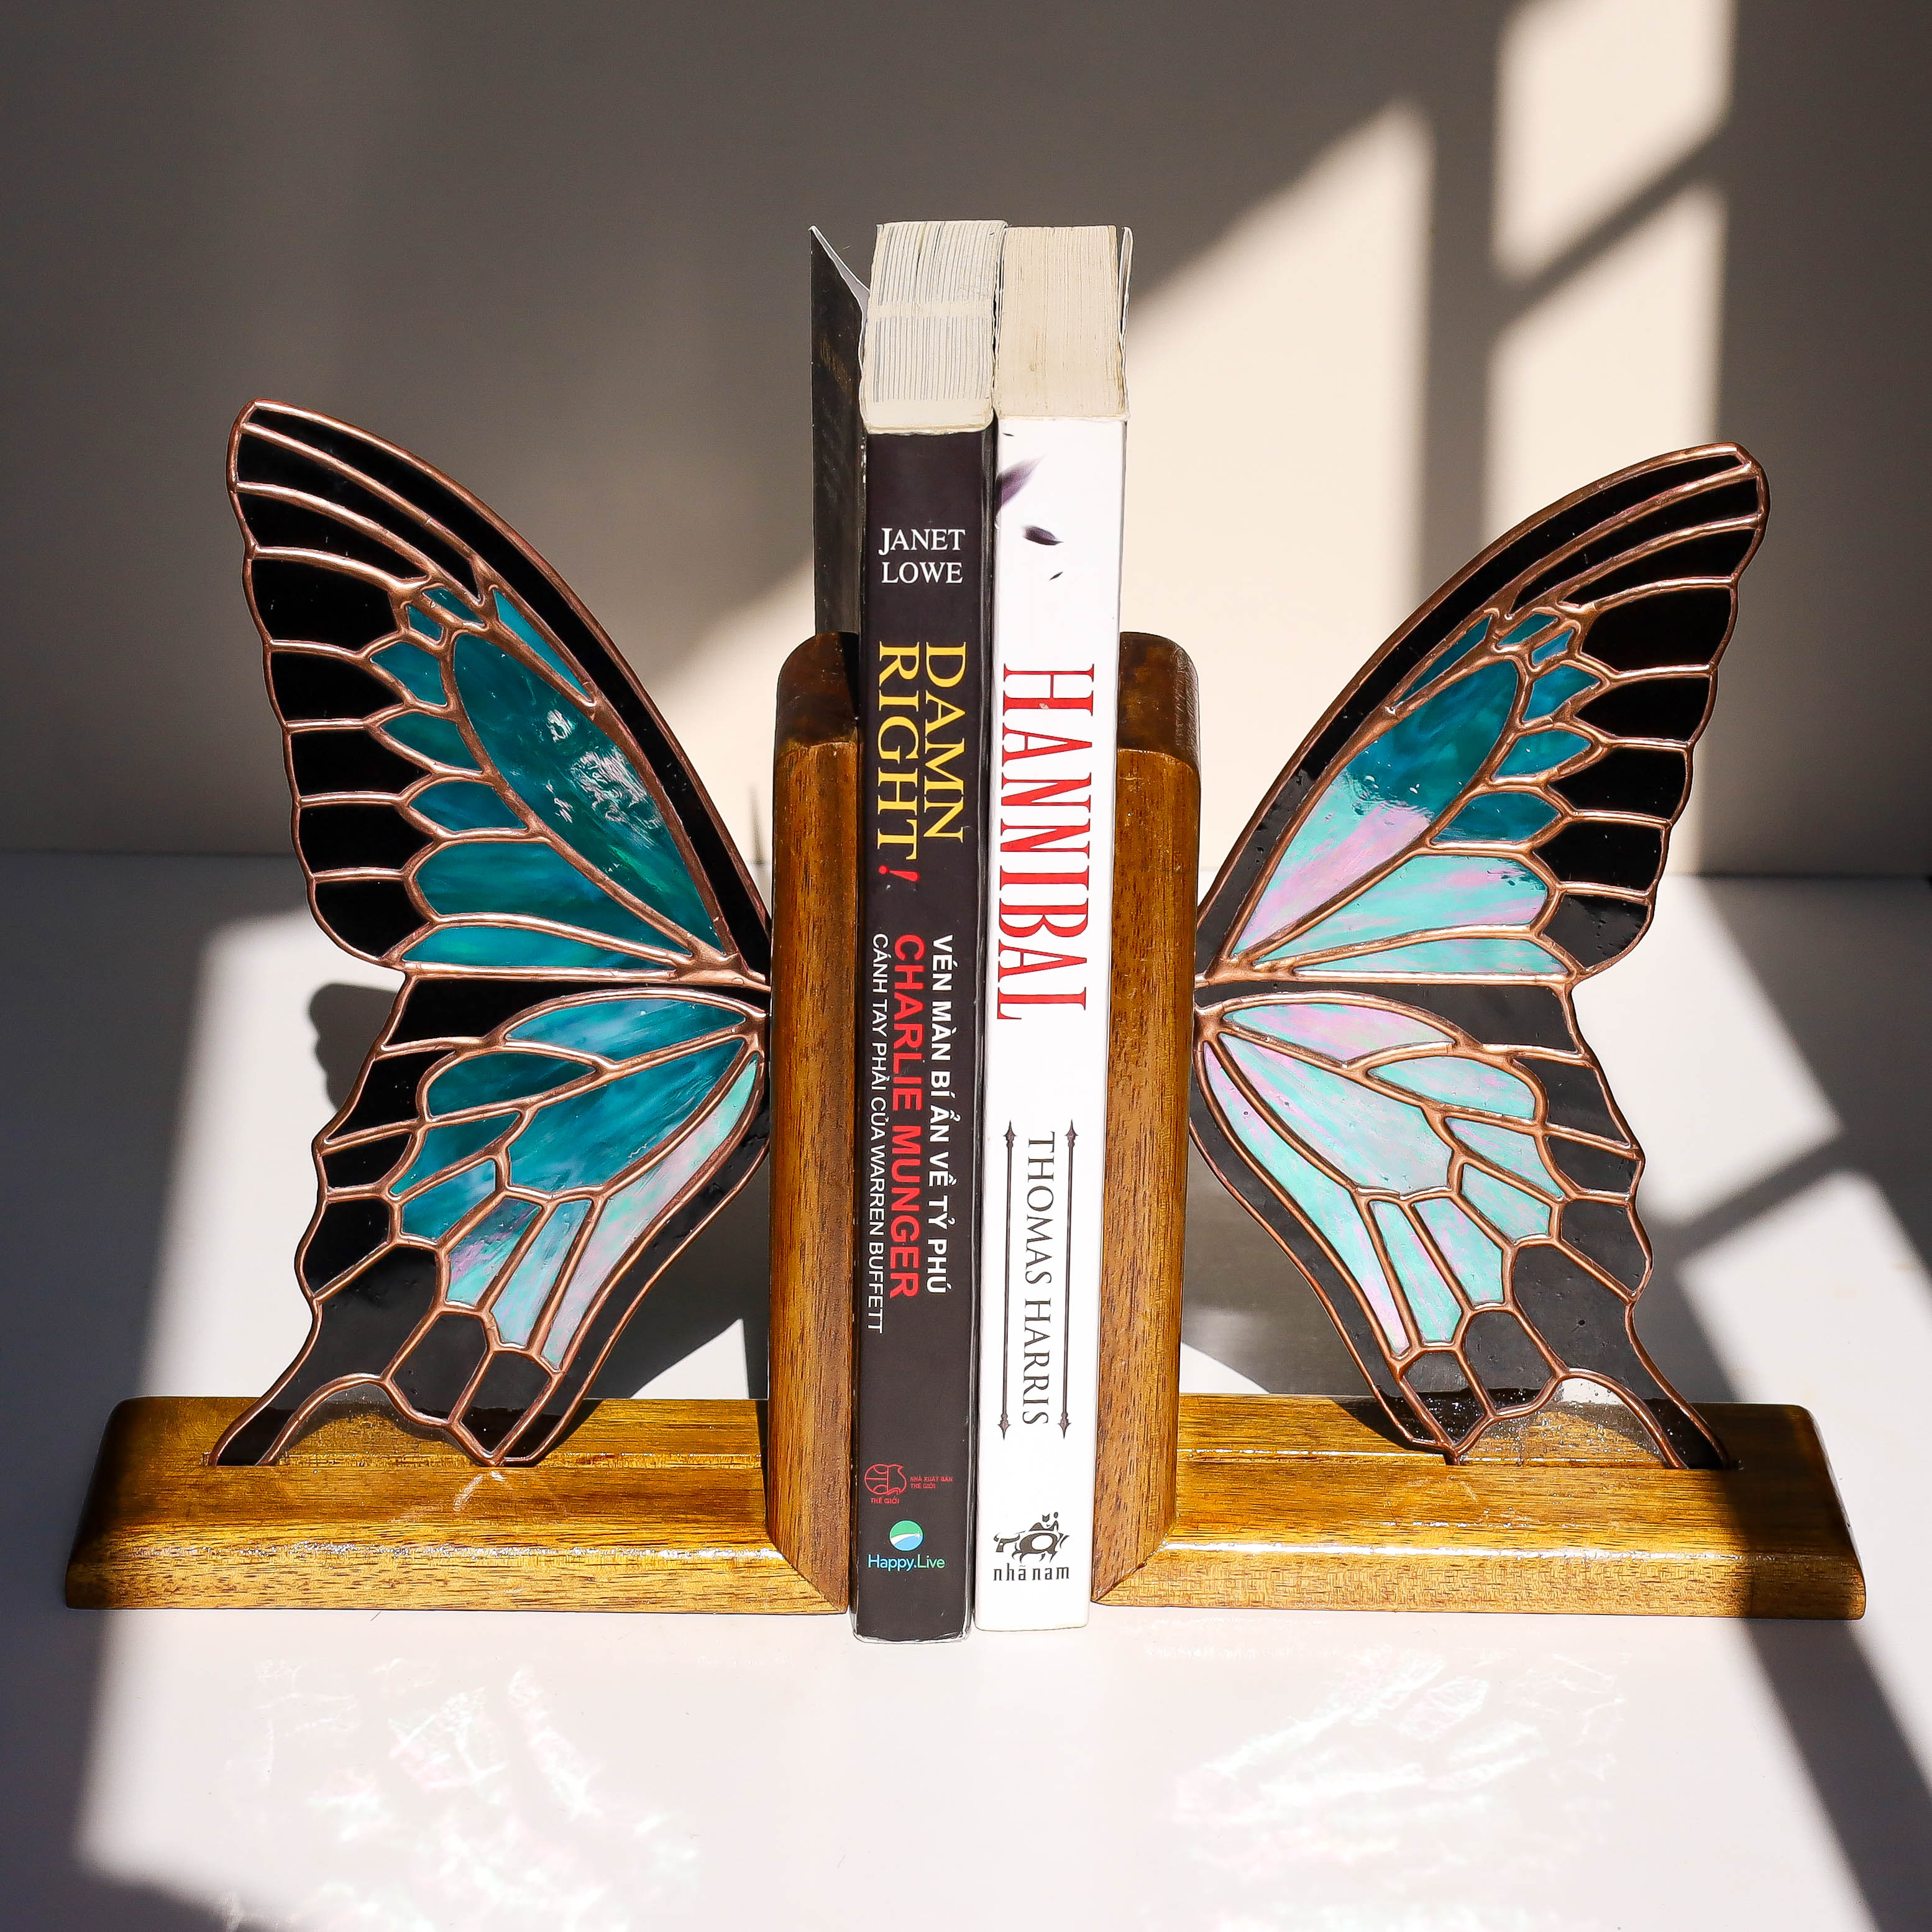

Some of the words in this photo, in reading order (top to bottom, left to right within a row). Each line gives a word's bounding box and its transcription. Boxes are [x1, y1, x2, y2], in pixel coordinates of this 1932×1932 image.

[878, 528, 966, 556] JANET
[881, 562, 963, 584] LOWE
[877, 641, 921, 882] RIGHT!
[923, 641, 968, 843] DAMN
[997, 663, 1095, 1020] HANNIBAL
[872, 933, 892, 993] CÁNH
[932, 935, 958, 991] VÉN
[872, 999, 887, 1037] TAY
[892, 933, 927, 1112] CHARLIE
[931, 1001, 957, 1061] MÀN
[871, 1043, 890, 1090] PHẢI
[930, 1071, 956, 1099] BÍ
[871, 1097, 889, 1141] CỦA
[930, 1105, 961, 1142] ẨN
[869, 1145, 886, 1235] WARREN
[928, 1151, 957, 1187] VỀ
[889, 1125, 923, 1298] MUNGER
[928, 1195, 955, 1230] TỶ
[1025, 1131, 1055, 1284] THOMAS
[868, 1242, 884, 1334] BUFFETT
[927, 1239, 952, 1293] PHÚ
[1022, 1298, 1051, 1424] HARRIS
[868, 1554, 945, 1572] Happy.Live
[993, 1562, 1026, 1582] nhã
[1032, 1567, 1069, 1580] nam
